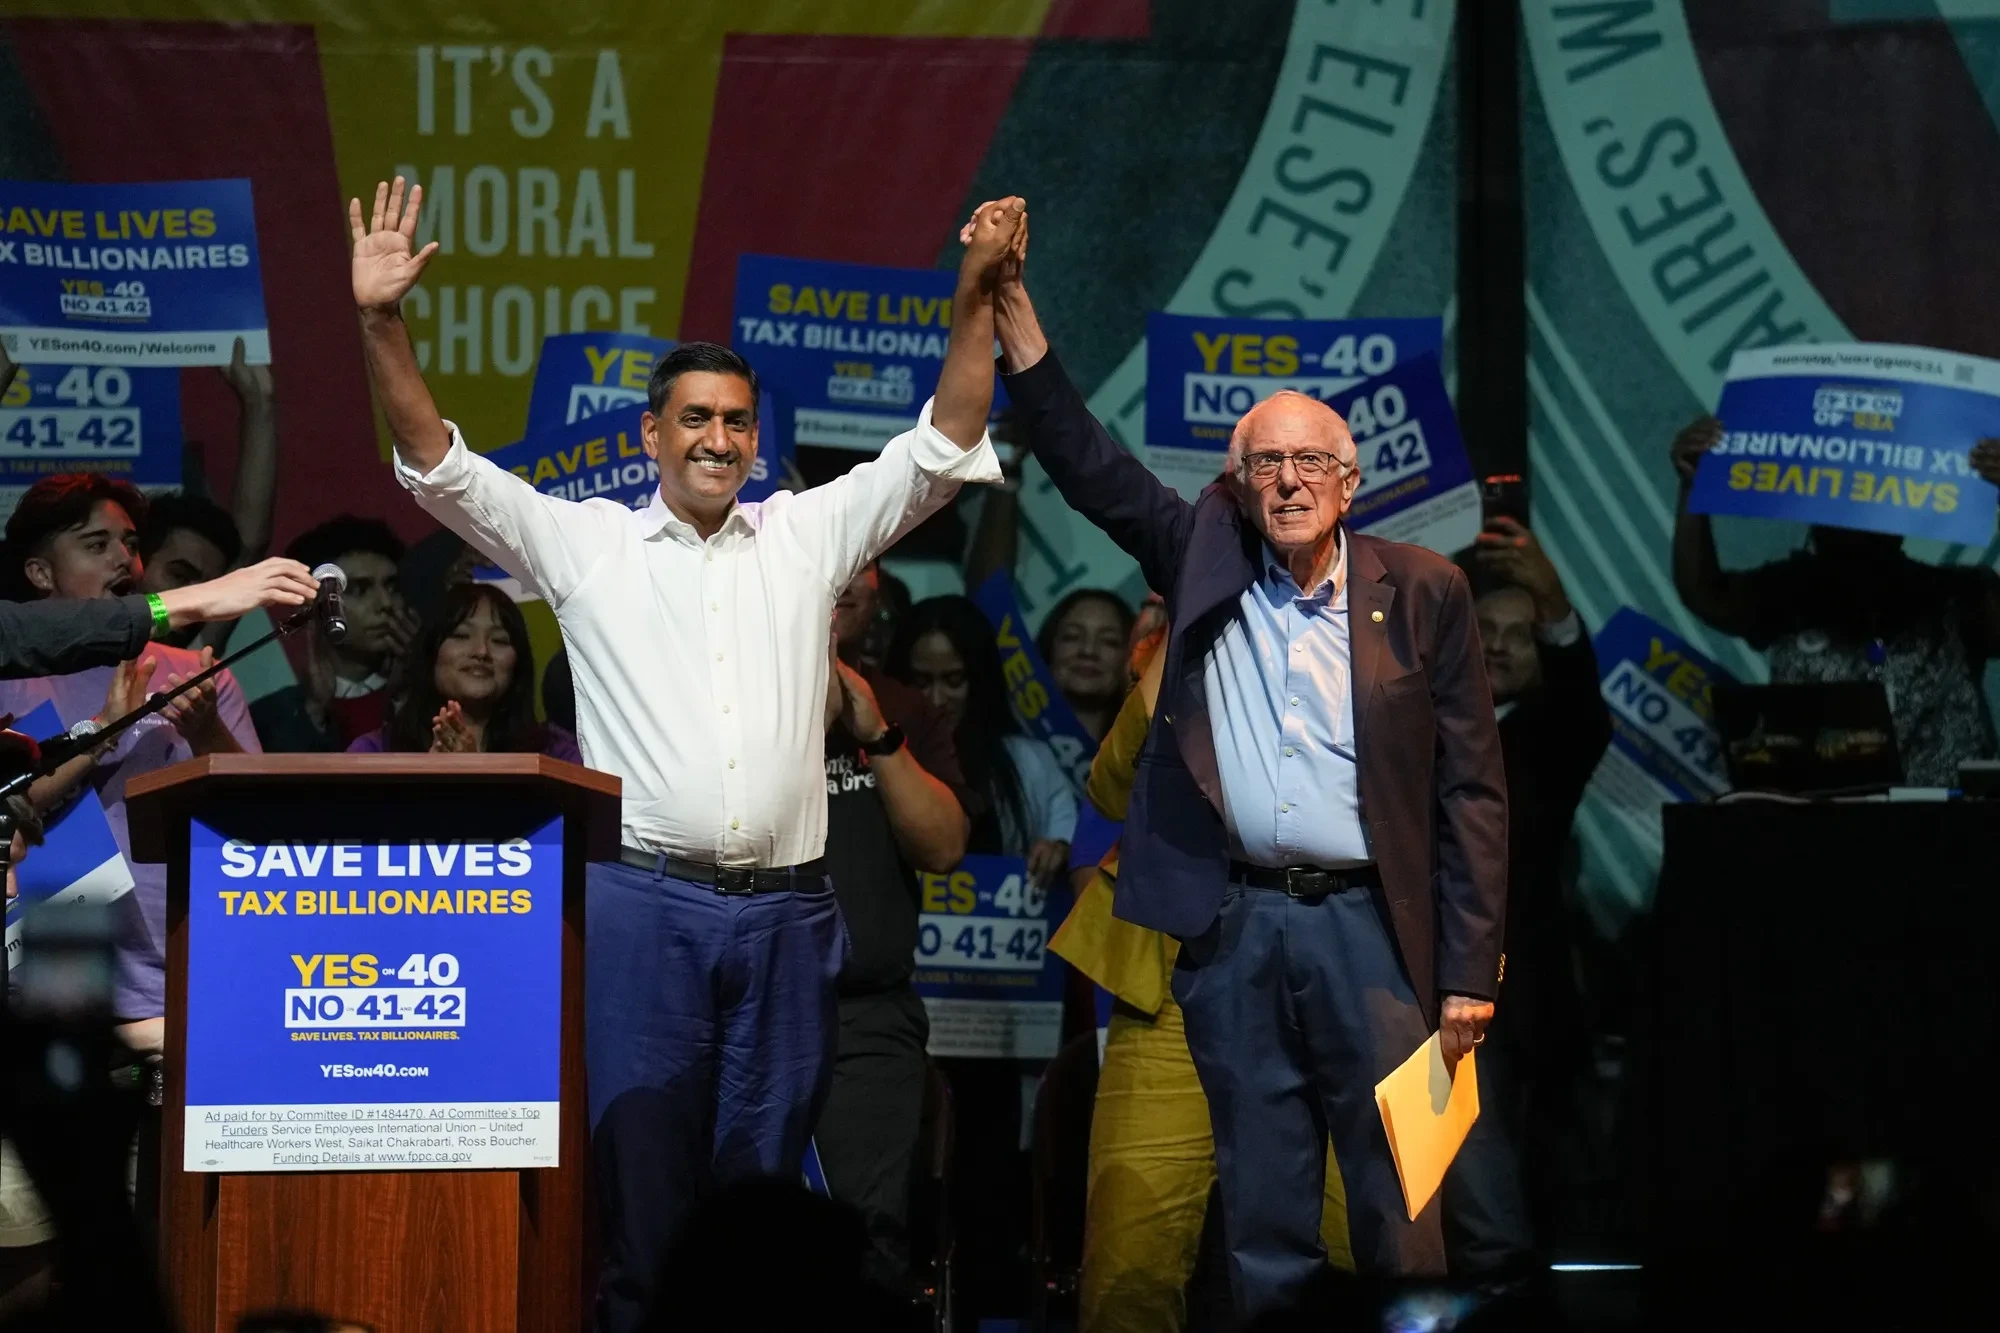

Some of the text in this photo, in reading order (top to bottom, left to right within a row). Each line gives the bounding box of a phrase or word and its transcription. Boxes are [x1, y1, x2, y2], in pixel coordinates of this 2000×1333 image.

[416, 45, 633, 139] IT'S A
[95, 208, 217, 240] LIVES
[394, 163, 656, 258] MORAL
[23, 243, 250, 271] BILLIONAIRES
[63, 299, 90, 312] NO
[113, 281, 145, 297] 40
[769, 284, 954, 328] SAVE LIVE
[739, 318, 798, 347] TAX
[583, 346, 654, 390] YE
[1193, 332, 1397, 376] YES 40
[55, 366, 132, 407] 40
[1192, 384, 1254, 416] NO
[1348, 384, 1408, 440] 40
[6, 416, 135, 448] 41 42
[1375, 434, 1423, 472] 42
[1728, 460, 1959, 512] SAVE LIVES
[996, 612, 1049, 720] YES
[1609, 672, 1668, 724] NO
[220, 838, 533, 878] SAVE LIVES
[218, 889, 533, 916] TAX BILLIONAIRES
[914, 869, 977, 915] ES
[953, 924, 996, 960] 41
[1006, 926, 1043, 961] 42
[291, 953, 460, 988] YES ON 40
[291, 995, 344, 1021] NO
[356, 994, 403, 1021] 41
[414, 994, 461, 1020] 42
[290, 1030, 460, 1042] SAVE LIVES. TAX BILLIONAIRES.
[204, 1111, 221, 1121] Ad
[224, 1111, 248, 1123] paid
[251, 1110, 267, 1121] for
[269, 1110, 284, 1123] by
[286, 1109, 348, 1121] Committee
[351, 1109, 364, 1120] ID
[429, 1108, 445, 1119] Ad
[447, 1107, 517, 1119] Committee's
[520, 1107, 541, 1120] Top
[221, 1125, 268, 1136] Funders
[271, 1124, 311, 1135] Service
[314, 1123, 374, 1136] Employees
[377, 1123, 442, 1134] International
[445, 1122, 477, 1133] Union
[489, 1121, 524, 1133] United
[205, 1139, 264, 1150] Healthcare
[266, 1138, 311, 1149] Workers
[314, 1138, 345, 1150] West,
[348, 1137, 383, 1149] Saikat
[458, 1136, 487, 1147] Ross
[272, 1150, 472, 1165] Funding Details at www.fppc.ca.gov
